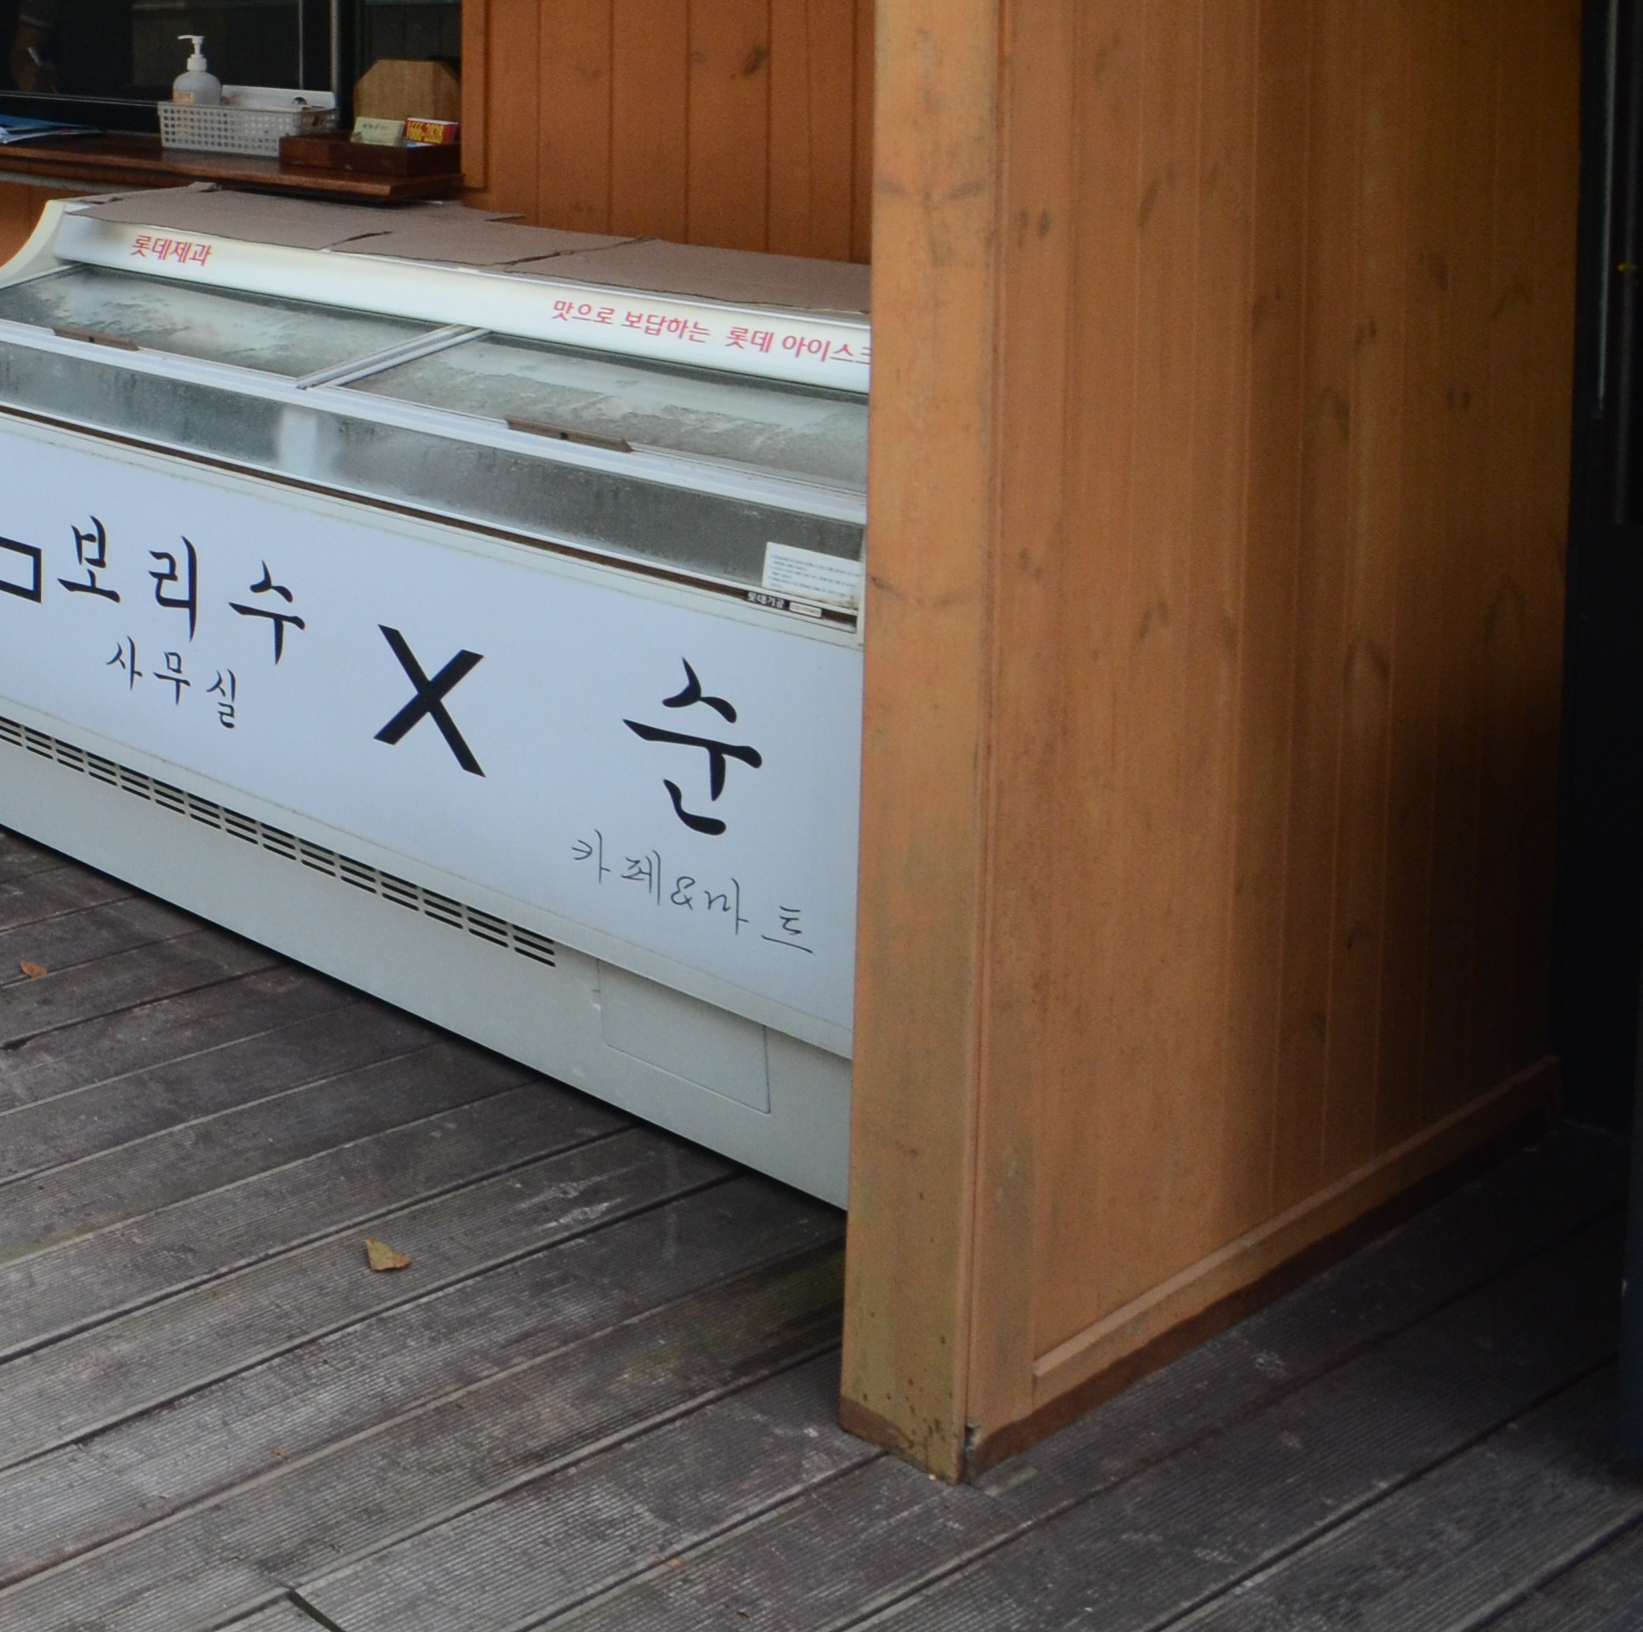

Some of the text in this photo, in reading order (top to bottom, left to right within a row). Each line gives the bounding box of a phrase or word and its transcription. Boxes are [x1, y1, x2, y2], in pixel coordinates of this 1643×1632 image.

[130, 234, 212, 266] 롯데제과
[551, 300, 616, 325] 맛으로
[620, 310, 711, 344] 보답하는
[725, 325, 775, 353] 롯데
[55, 514, 764, 836] 보리수 X 순
[105, 634, 236, 730] 사무실
